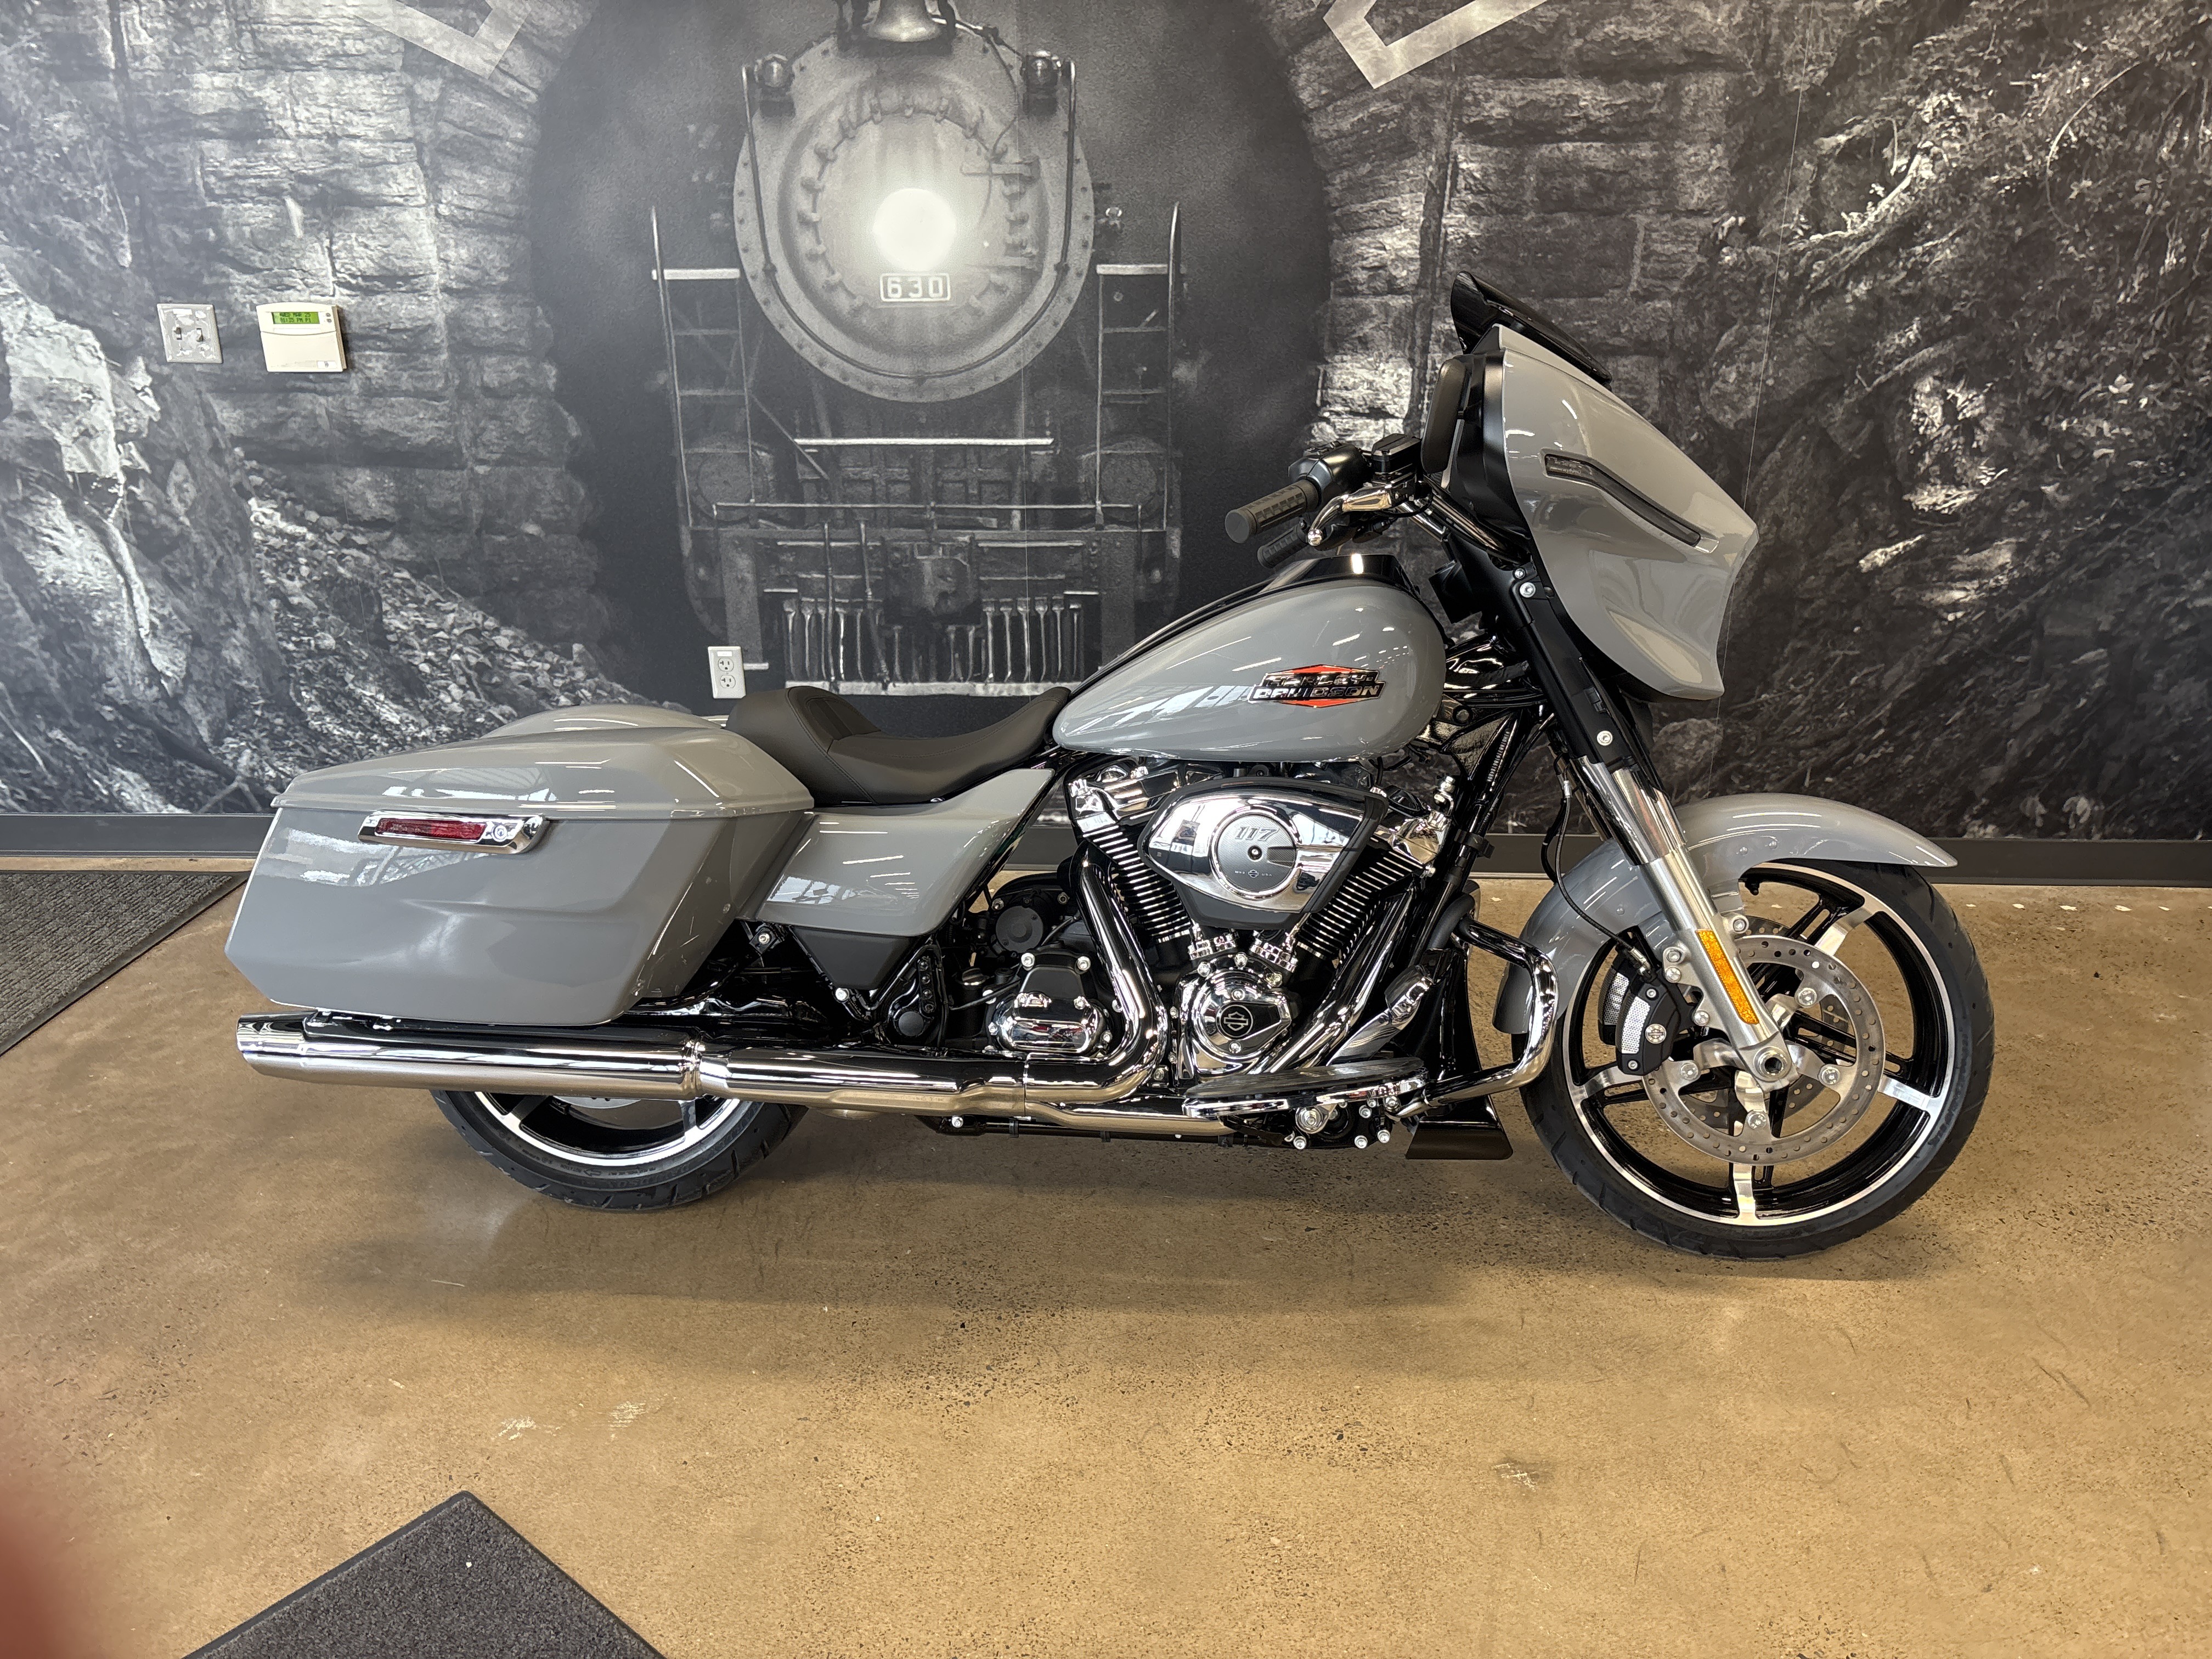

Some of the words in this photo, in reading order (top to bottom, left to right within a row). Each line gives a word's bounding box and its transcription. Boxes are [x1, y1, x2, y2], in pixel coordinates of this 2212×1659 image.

[887, 276, 943, 298] 630
[1252, 685, 1380, 698] DAVIDSON
[1235, 826, 1280, 841] 117
